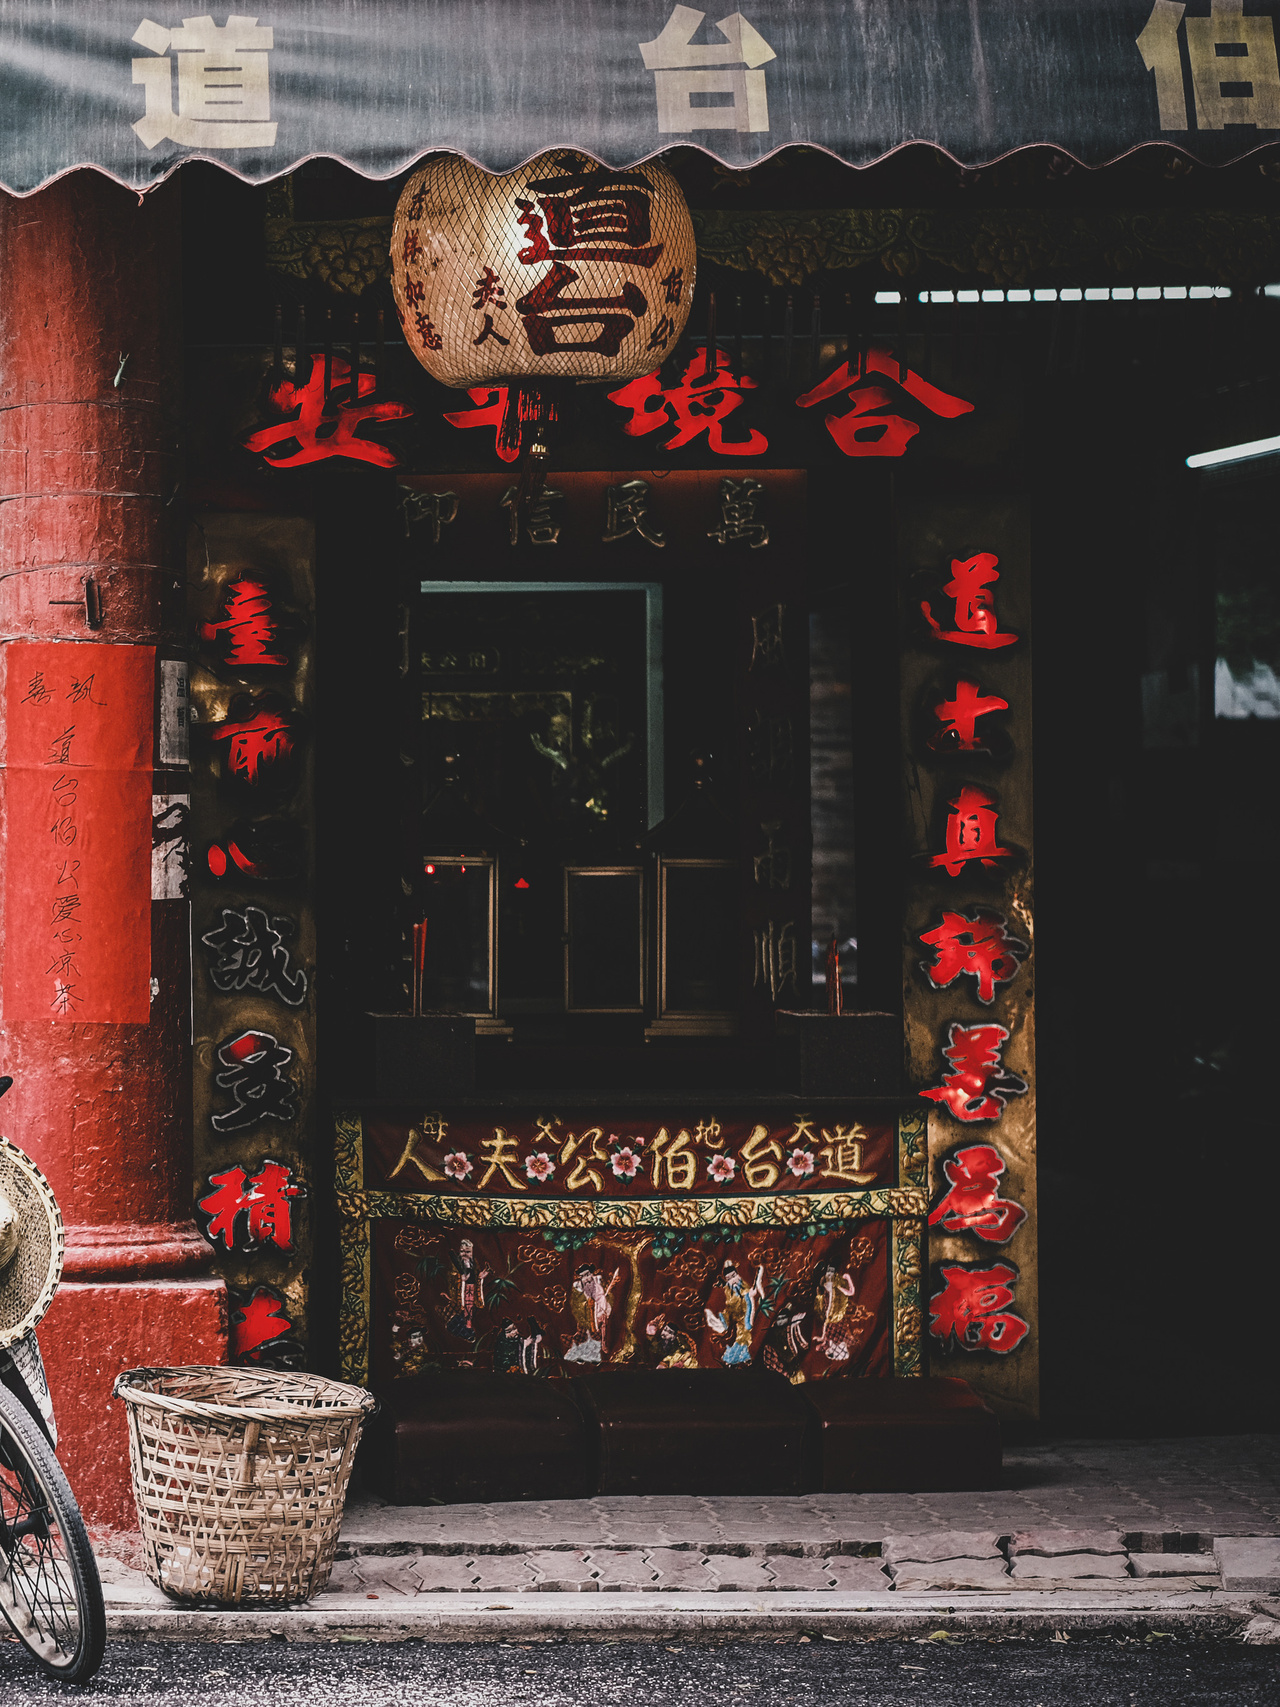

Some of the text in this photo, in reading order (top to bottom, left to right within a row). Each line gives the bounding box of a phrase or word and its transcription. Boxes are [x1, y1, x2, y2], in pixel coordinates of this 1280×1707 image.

[515, 154, 665, 357] 道台
[472, 265, 510, 346] 夫人
[386, 1121, 878, 1191] 道台伯公夫人
